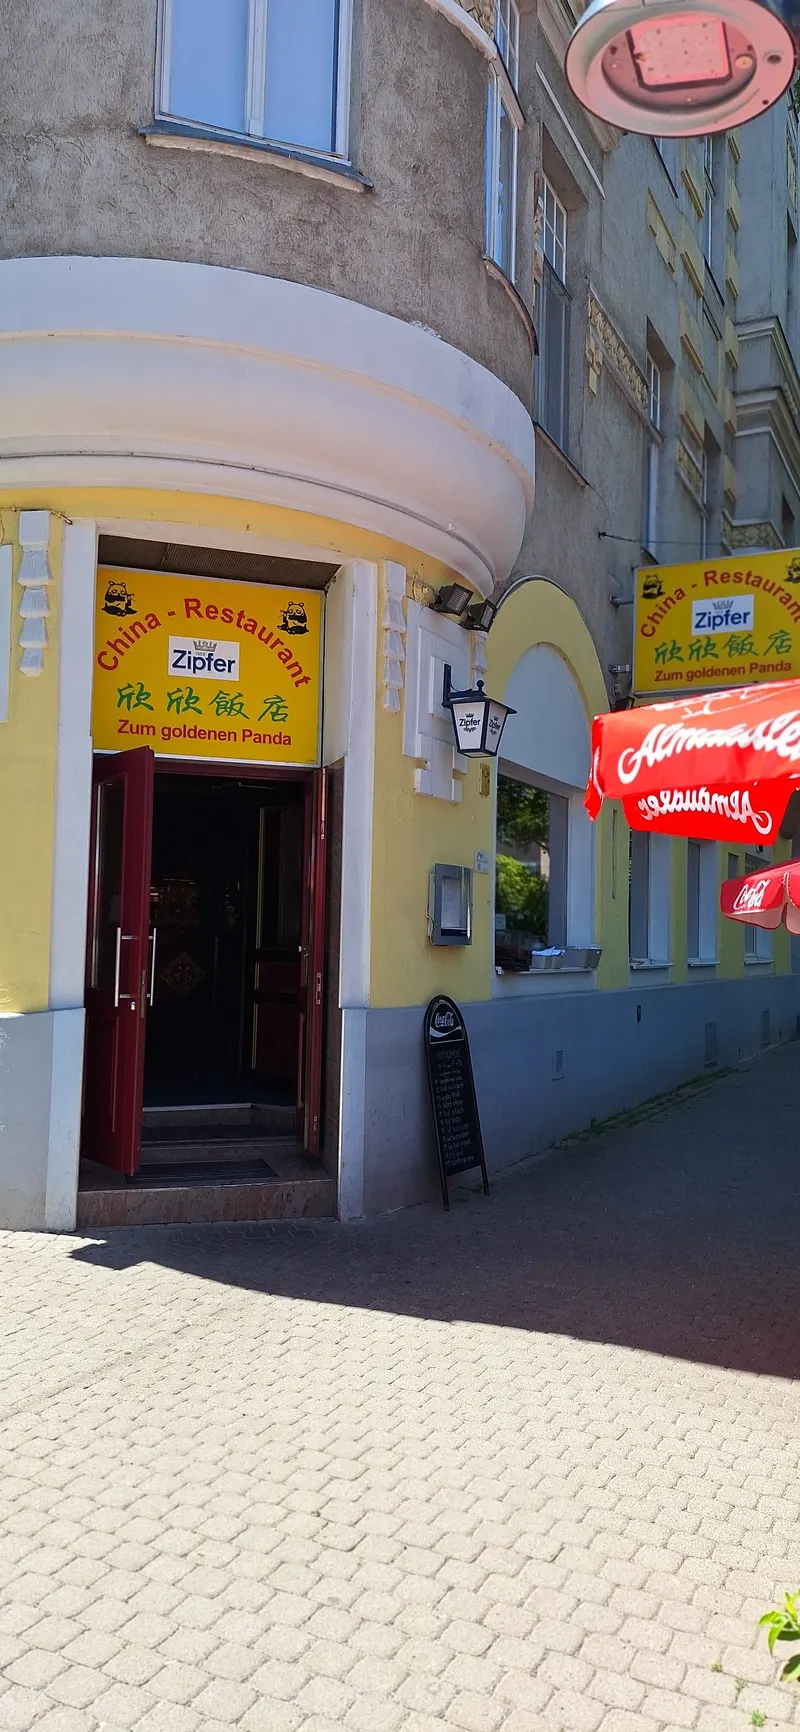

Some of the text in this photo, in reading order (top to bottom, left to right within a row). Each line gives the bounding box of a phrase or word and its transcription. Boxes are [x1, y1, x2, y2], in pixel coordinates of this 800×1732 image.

[641, 587, 686, 638] China
[695, 609, 751, 631] Zipfer
[97, 612, 162, 672] China
[184, 597, 312, 688] Restaurant
[172, 649, 236, 674] Zipfer
[655, 660, 792, 684] Zum goldenen Panda
[117, 719, 292, 746] Zum goldenen Panda
[459, 717, 481, 727] Zipfer
[617, 709, 800, 784] Almdudle
